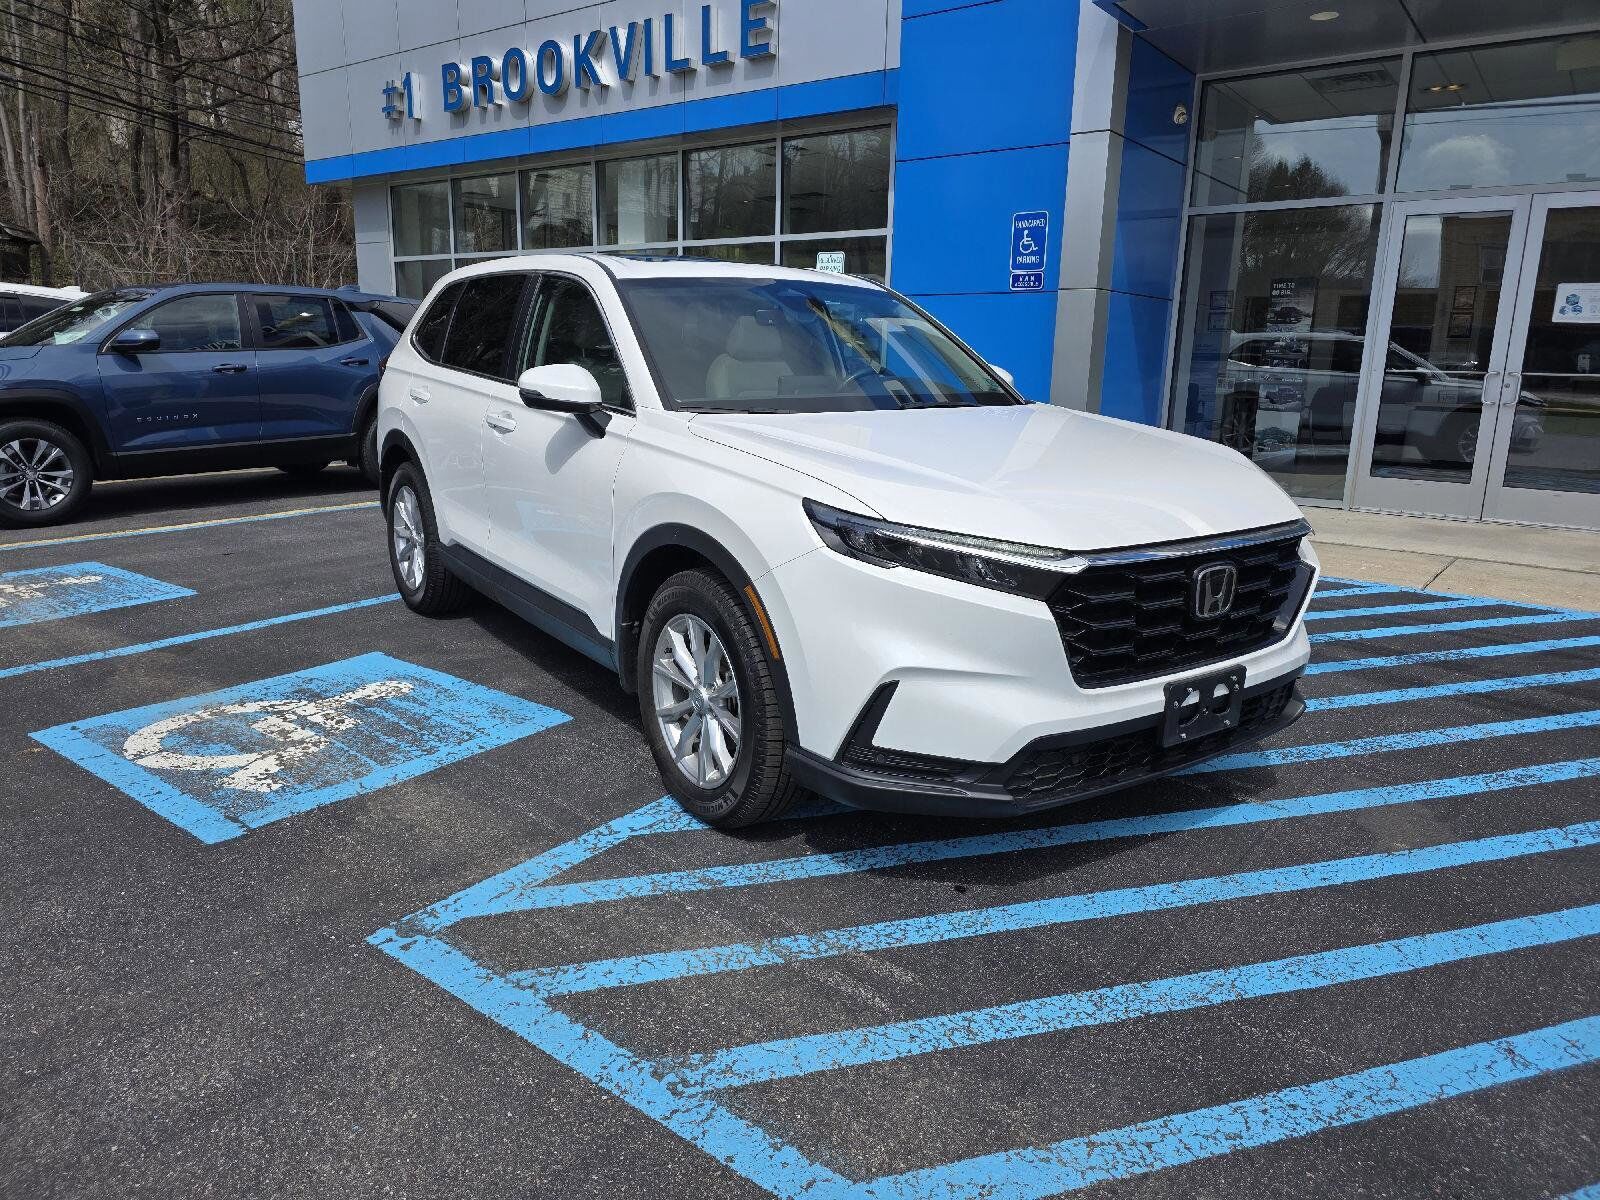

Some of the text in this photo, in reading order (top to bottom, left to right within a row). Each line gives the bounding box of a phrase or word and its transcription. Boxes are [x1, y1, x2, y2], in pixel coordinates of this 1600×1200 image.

[382, 0, 775, 119] #1 BROOKVILLE
[1016, 255, 1040, 264] PARKING
